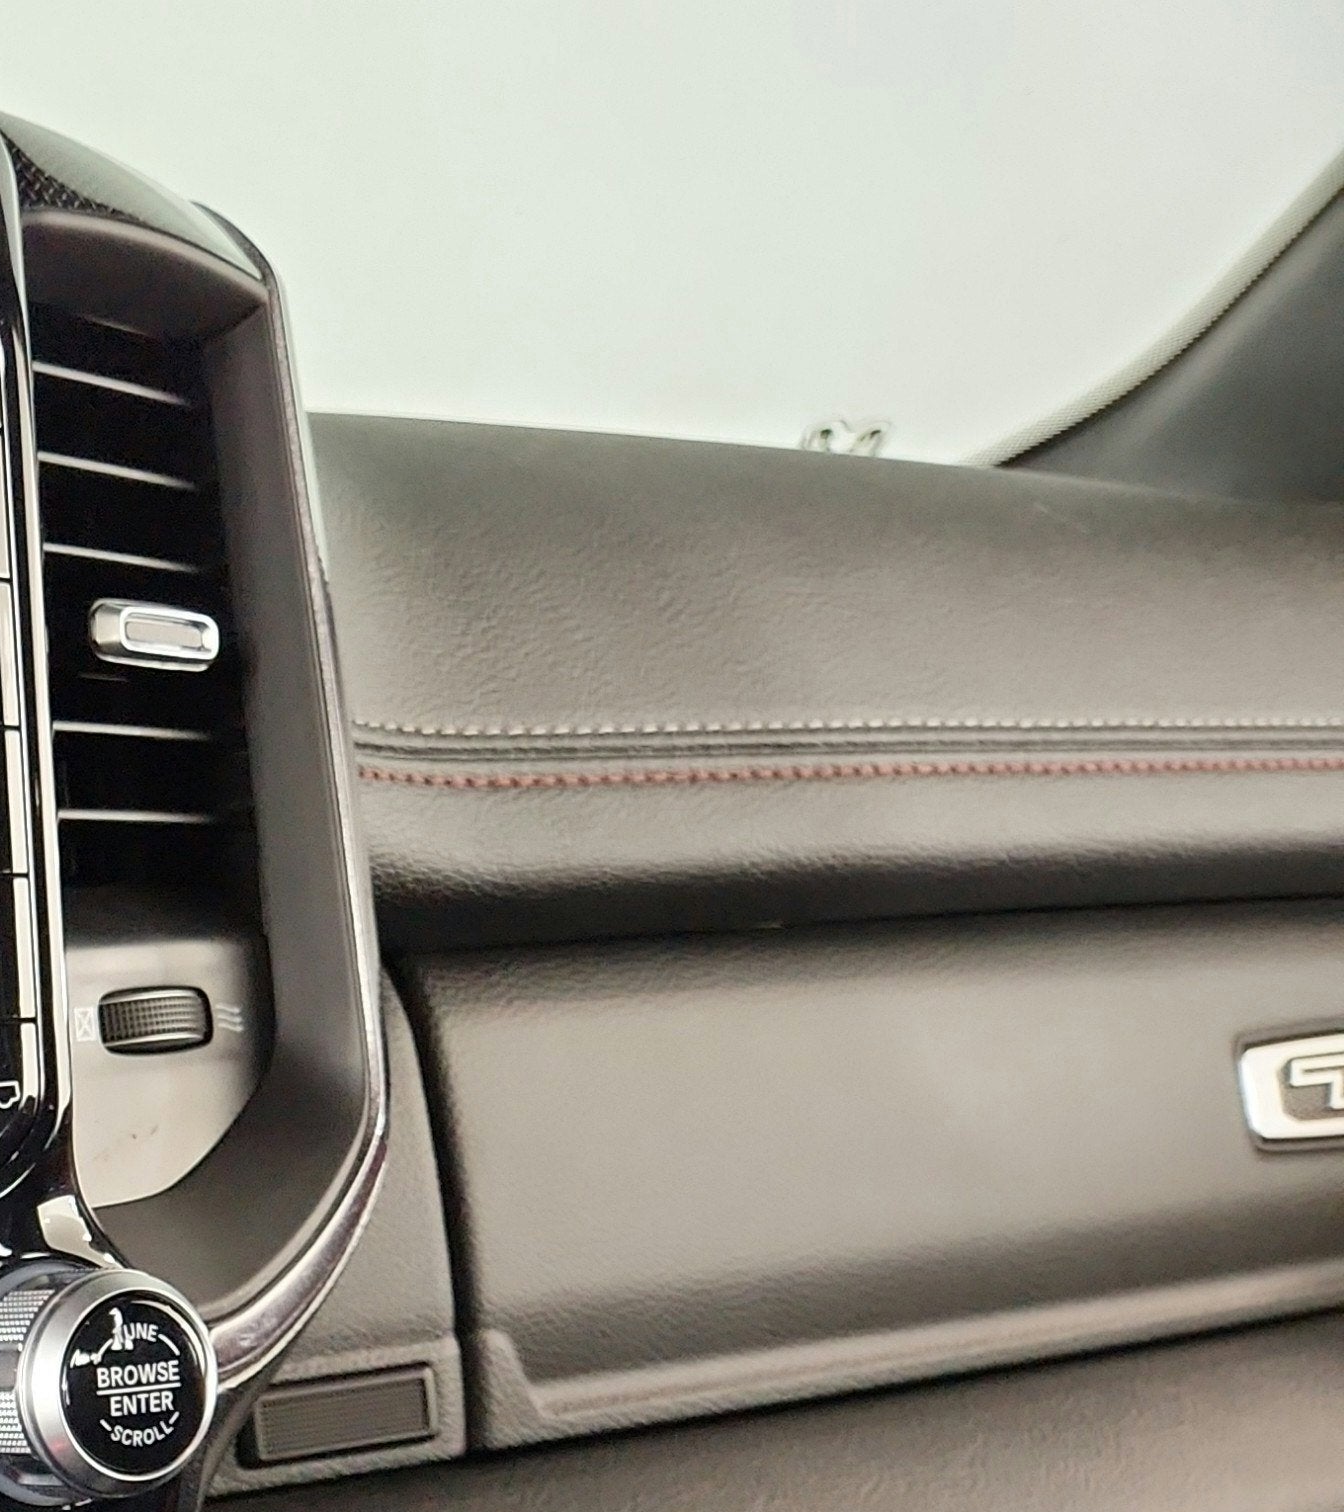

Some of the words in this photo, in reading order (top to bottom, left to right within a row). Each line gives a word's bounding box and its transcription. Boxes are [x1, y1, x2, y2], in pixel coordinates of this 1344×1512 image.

[96, 1359, 181, 1388] BROWSE
[109, 1390, 174, 1417] ENTER
[110, 1420, 175, 1447] SCROLL
